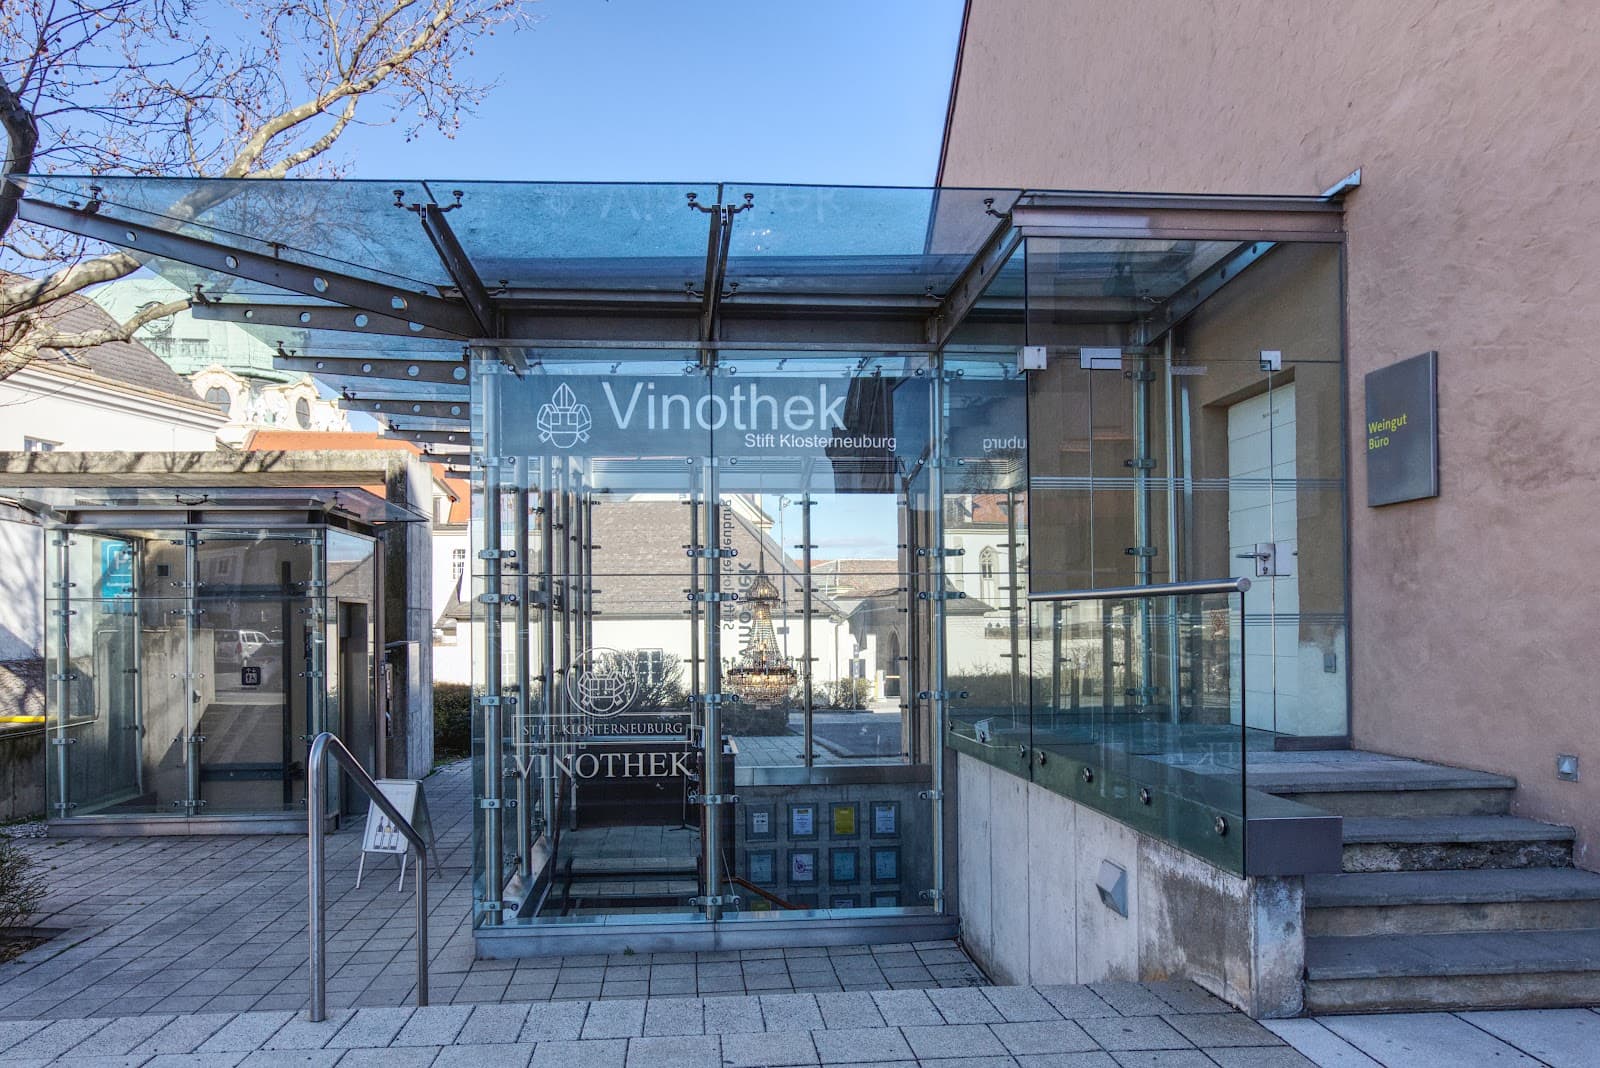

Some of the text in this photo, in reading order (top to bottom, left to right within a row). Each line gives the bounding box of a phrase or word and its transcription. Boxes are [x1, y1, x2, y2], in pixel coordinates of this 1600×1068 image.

[602, 382, 847, 430] Vinothek
[1368, 413, 1407, 433] Weingut
[744, 433, 897, 451] Stift Klosterneuburg
[1368, 435, 1389, 449] Büro
[523, 722, 683, 735] STIFT KLOSTERNEUBURG
[513, 752, 694, 779] VINOTHEK
